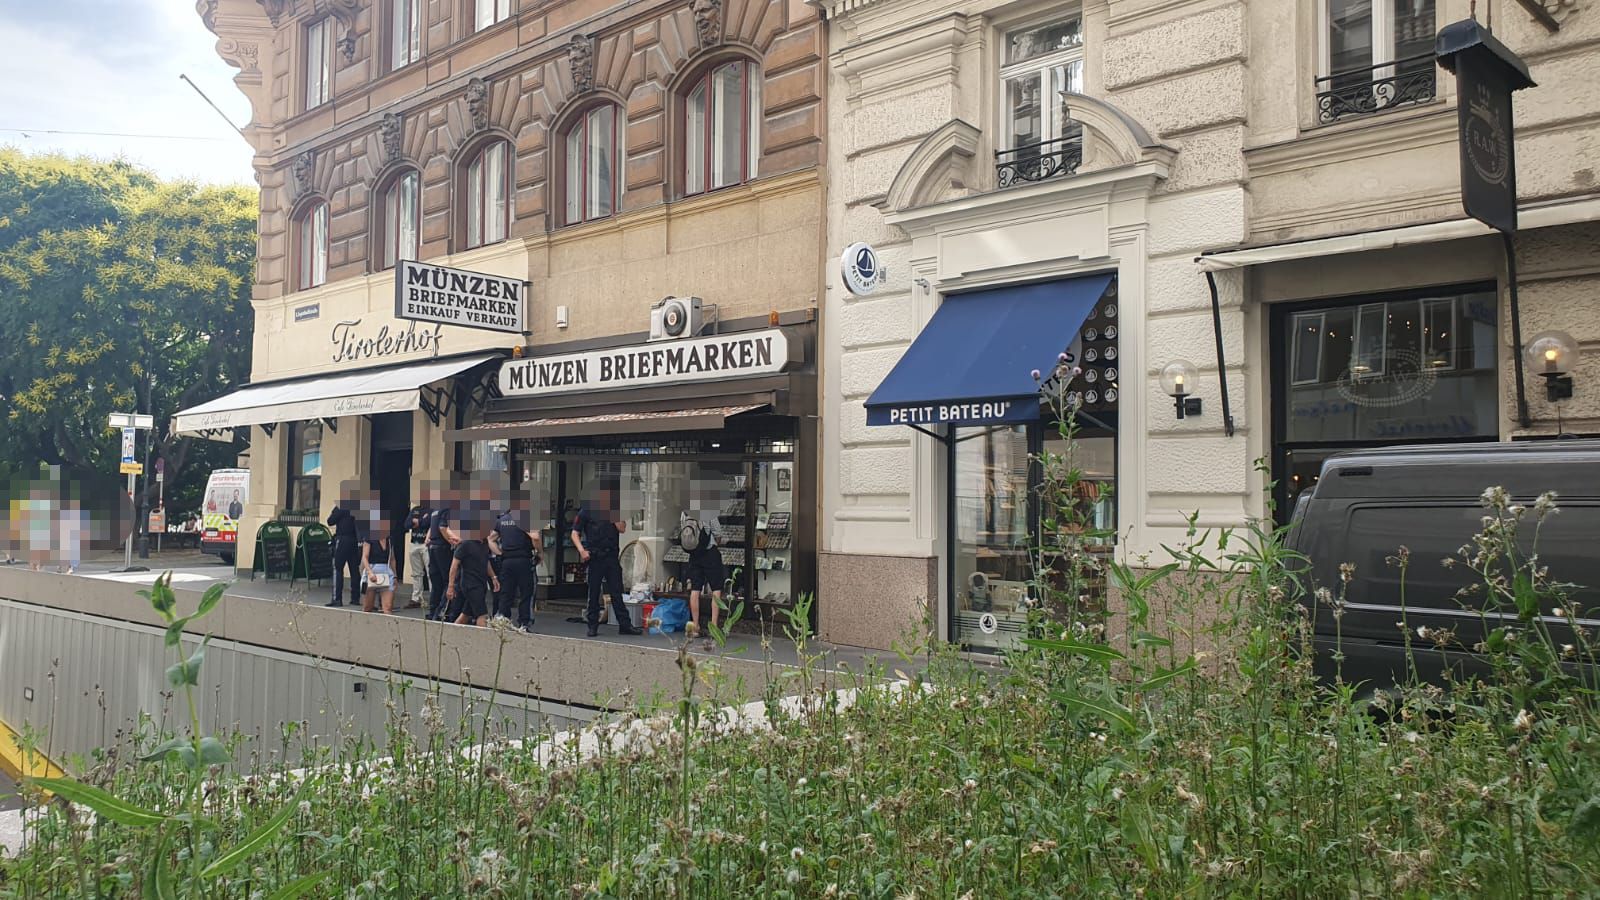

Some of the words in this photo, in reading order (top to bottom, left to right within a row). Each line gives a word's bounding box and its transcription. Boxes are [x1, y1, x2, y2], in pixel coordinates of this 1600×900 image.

[407, 265, 519, 301] MÜNZEN
[407, 303, 460, 319] EINKAUF
[466, 311, 517, 327] VERKAUF
[409, 287, 517, 316] BRIEFMARKEN
[332, 318, 443, 362] Tirolerhof
[509, 359, 588, 390] MÜNZEN
[600, 336, 773, 382] BRIEFMARKEN
[890, 406, 933, 423] PETIT
